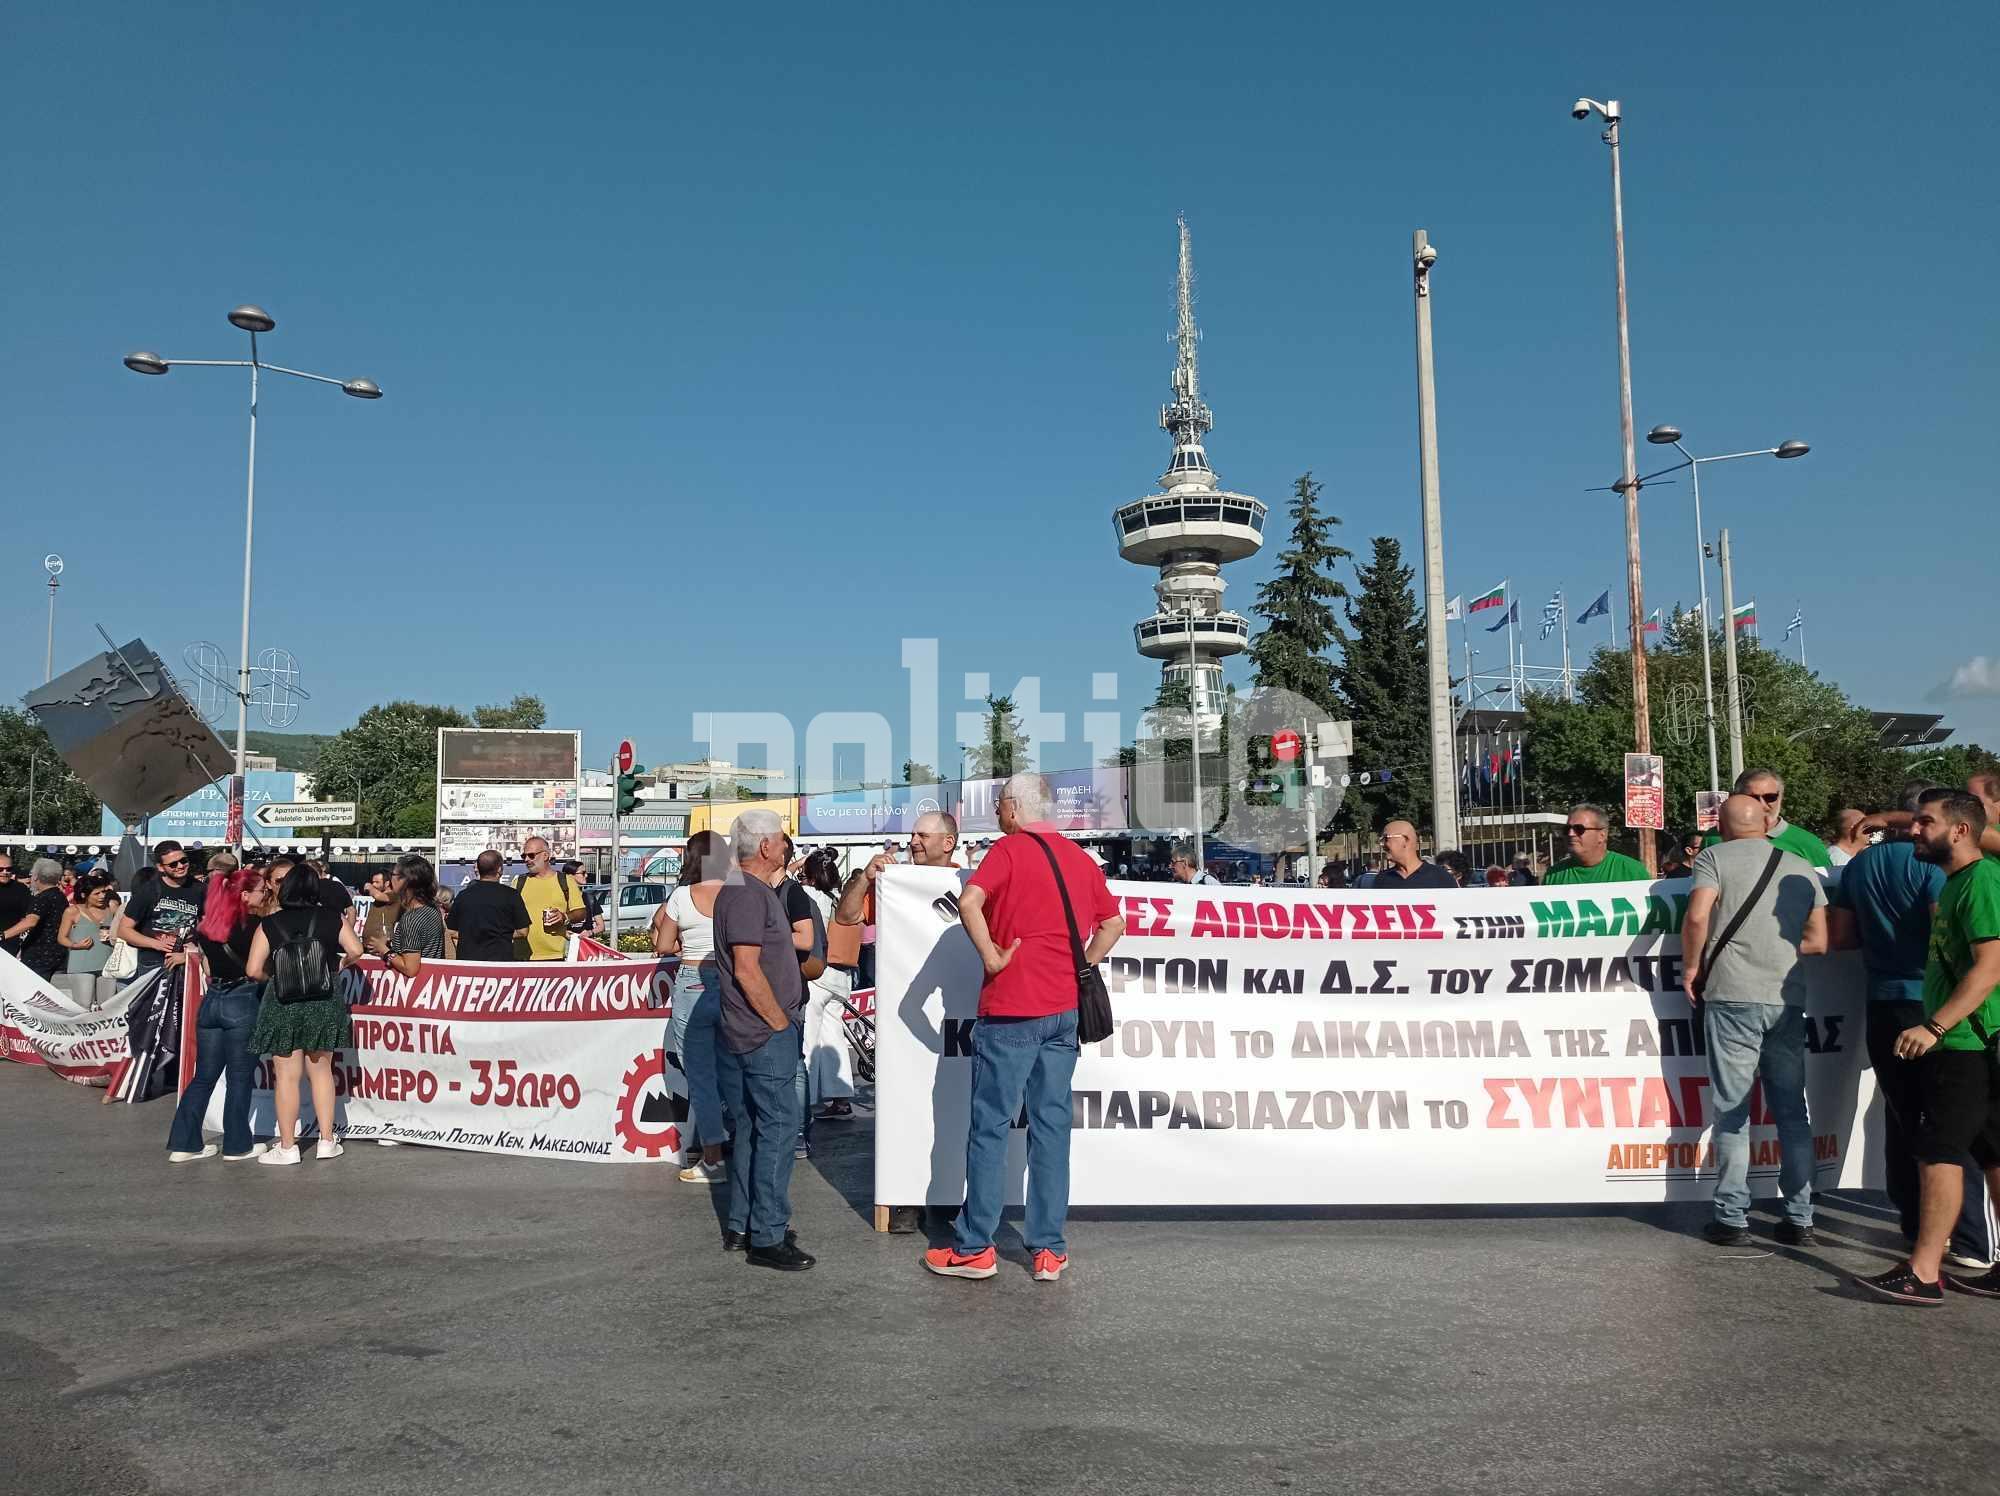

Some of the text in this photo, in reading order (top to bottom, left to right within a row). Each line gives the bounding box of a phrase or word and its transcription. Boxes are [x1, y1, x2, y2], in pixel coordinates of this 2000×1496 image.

[201, 810, 229, 818] ΤΡΑΠΕ
[1190, 899, 1444, 940] ΑΠΟΛΥΣΕΙΣ
[1453, 915, 1526, 940] ΣΤΗΝ
[366, 970, 416, 1009] ΤΩΝ
[412, 974, 594, 1013] ΑΝΤΕΡΓΑΤΙΚΩΝ
[590, 970, 676, 1012] ΝΟΜΩ
[1243, 968, 1305, 994] ΚΑΙ
[1319, 959, 1410, 995] Δ.Σ.
[1427, 968, 1493, 995] ΤΟΥ
[1506, 955, 1685, 994] ΣΩΜΑΤΕ
[418, 1023, 457, 1056] ΓΙΑ
[1230, 1030, 1275, 1059] ΤΟ
[1291, 1019, 1532, 1059] ΔΙΚΑΙΩΜΑ
[1544, 1028, 1610, 1058] ΤΗΣ
[469, 1059, 582, 1110] 35ΩΡΟ
[1072, 1090, 1411, 1130] ΠΑΡΑΒΙΑΖΟΥΝ
[1423, 1100, 1469, 1130] ΤΟ
